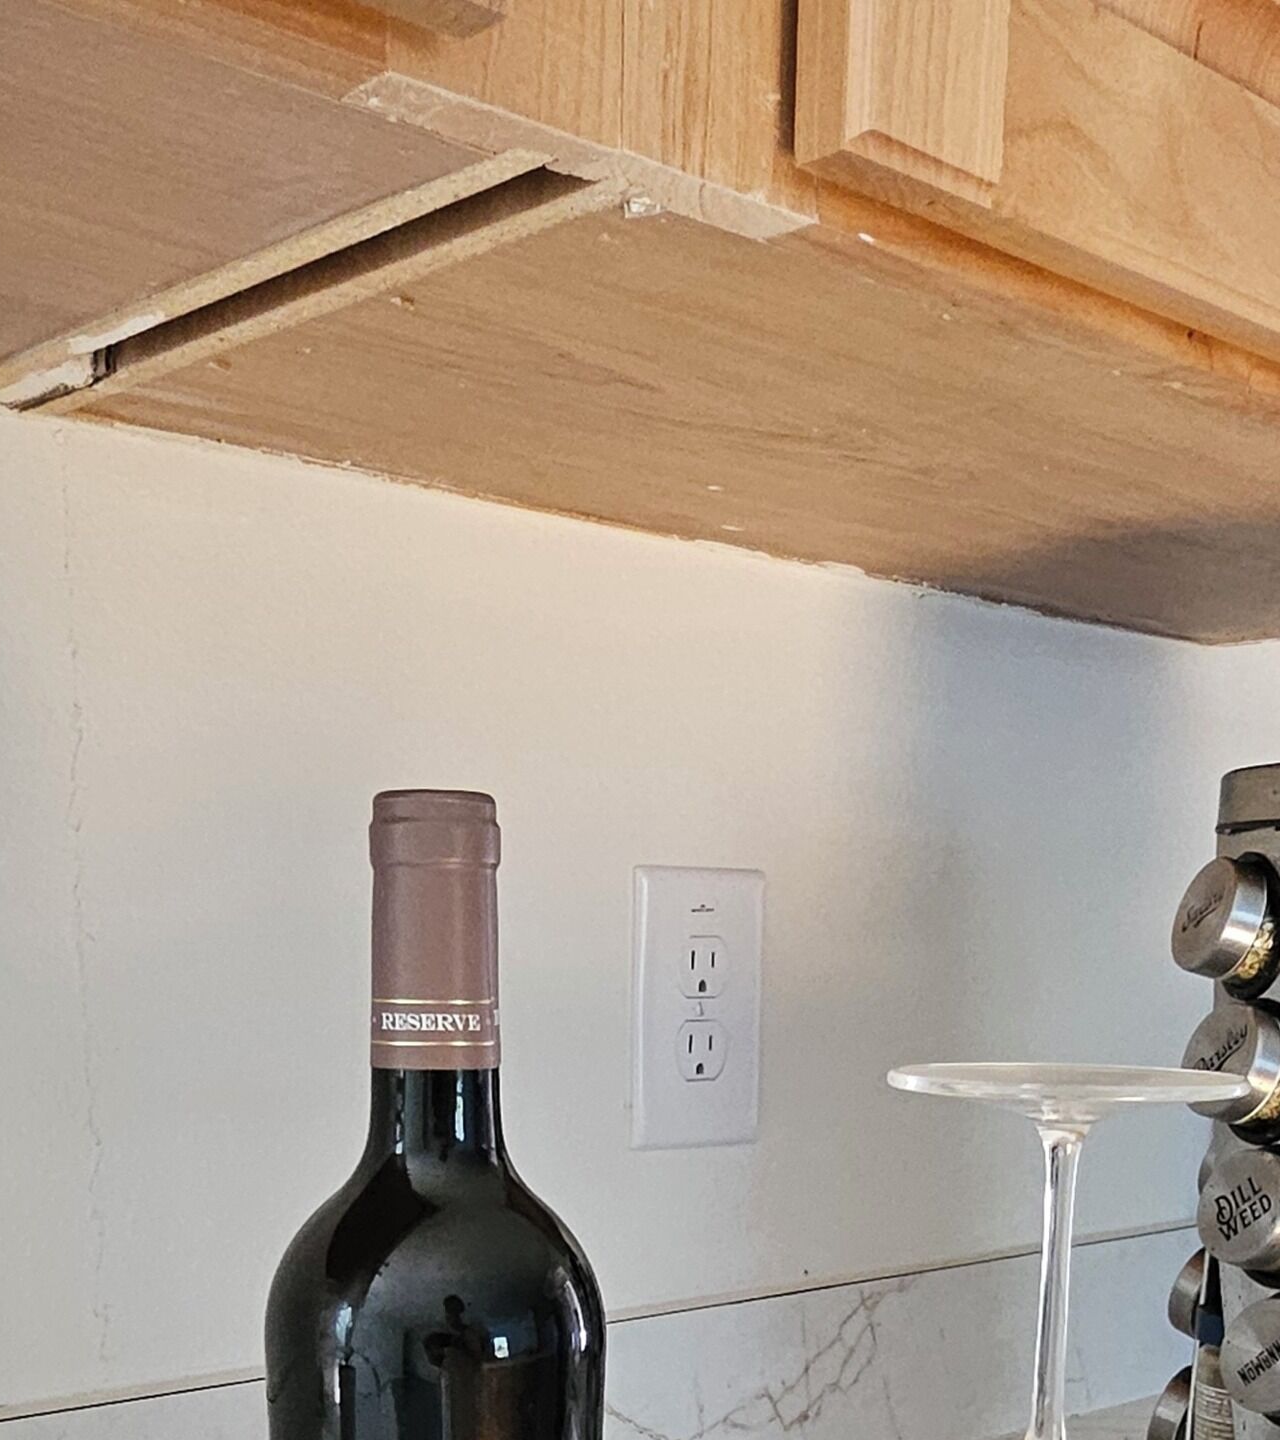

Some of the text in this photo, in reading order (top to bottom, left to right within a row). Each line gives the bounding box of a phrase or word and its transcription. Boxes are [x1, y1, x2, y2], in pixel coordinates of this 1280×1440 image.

[381, 1012, 481, 1031] RESERVE
[1214, 1176, 1262, 1225] DILL
[1218, 1194, 1272, 1242] WEED
